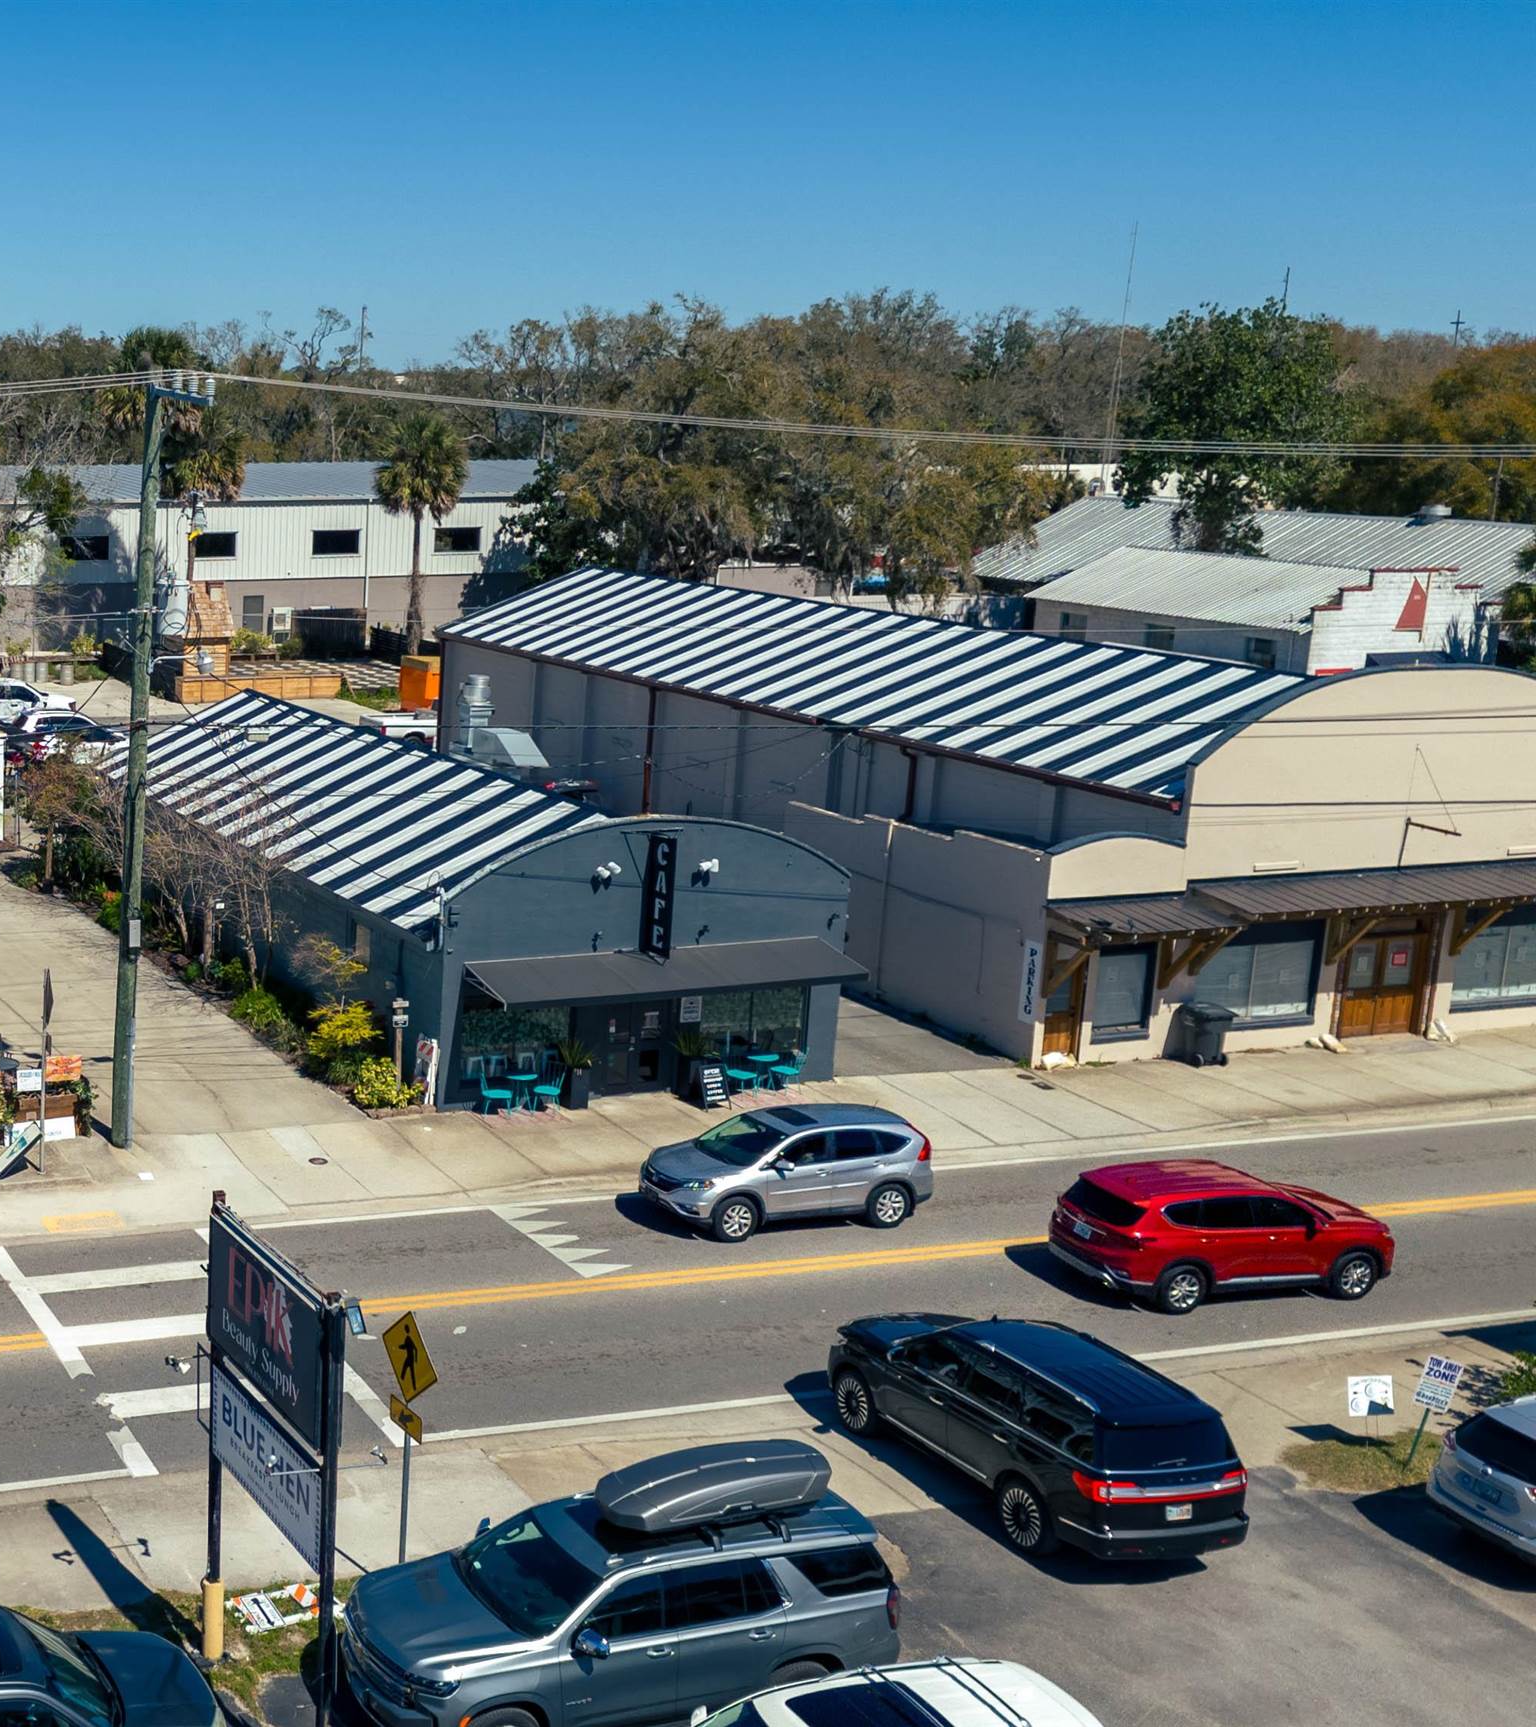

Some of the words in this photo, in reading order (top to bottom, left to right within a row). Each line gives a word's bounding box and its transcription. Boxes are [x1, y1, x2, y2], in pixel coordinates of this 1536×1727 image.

[652, 842, 669, 949] CAFE
[1024, 947, 1038, 1015] PARKING
[222, 1307, 260, 1364] Beauty
[261, 1347, 300, 1407] Supply
[1425, 1367, 1458, 1384] ZONE
[1429, 1356, 1443, 1368] TOW
[1443, 1360, 1462, 1374] AWAY
[221, 1393, 266, 1464] BLUE
[270, 1444, 310, 1516] HEN
[229, 1435, 266, 1484] BREAKFAST
[275, 1487, 301, 1522] LUNCH
